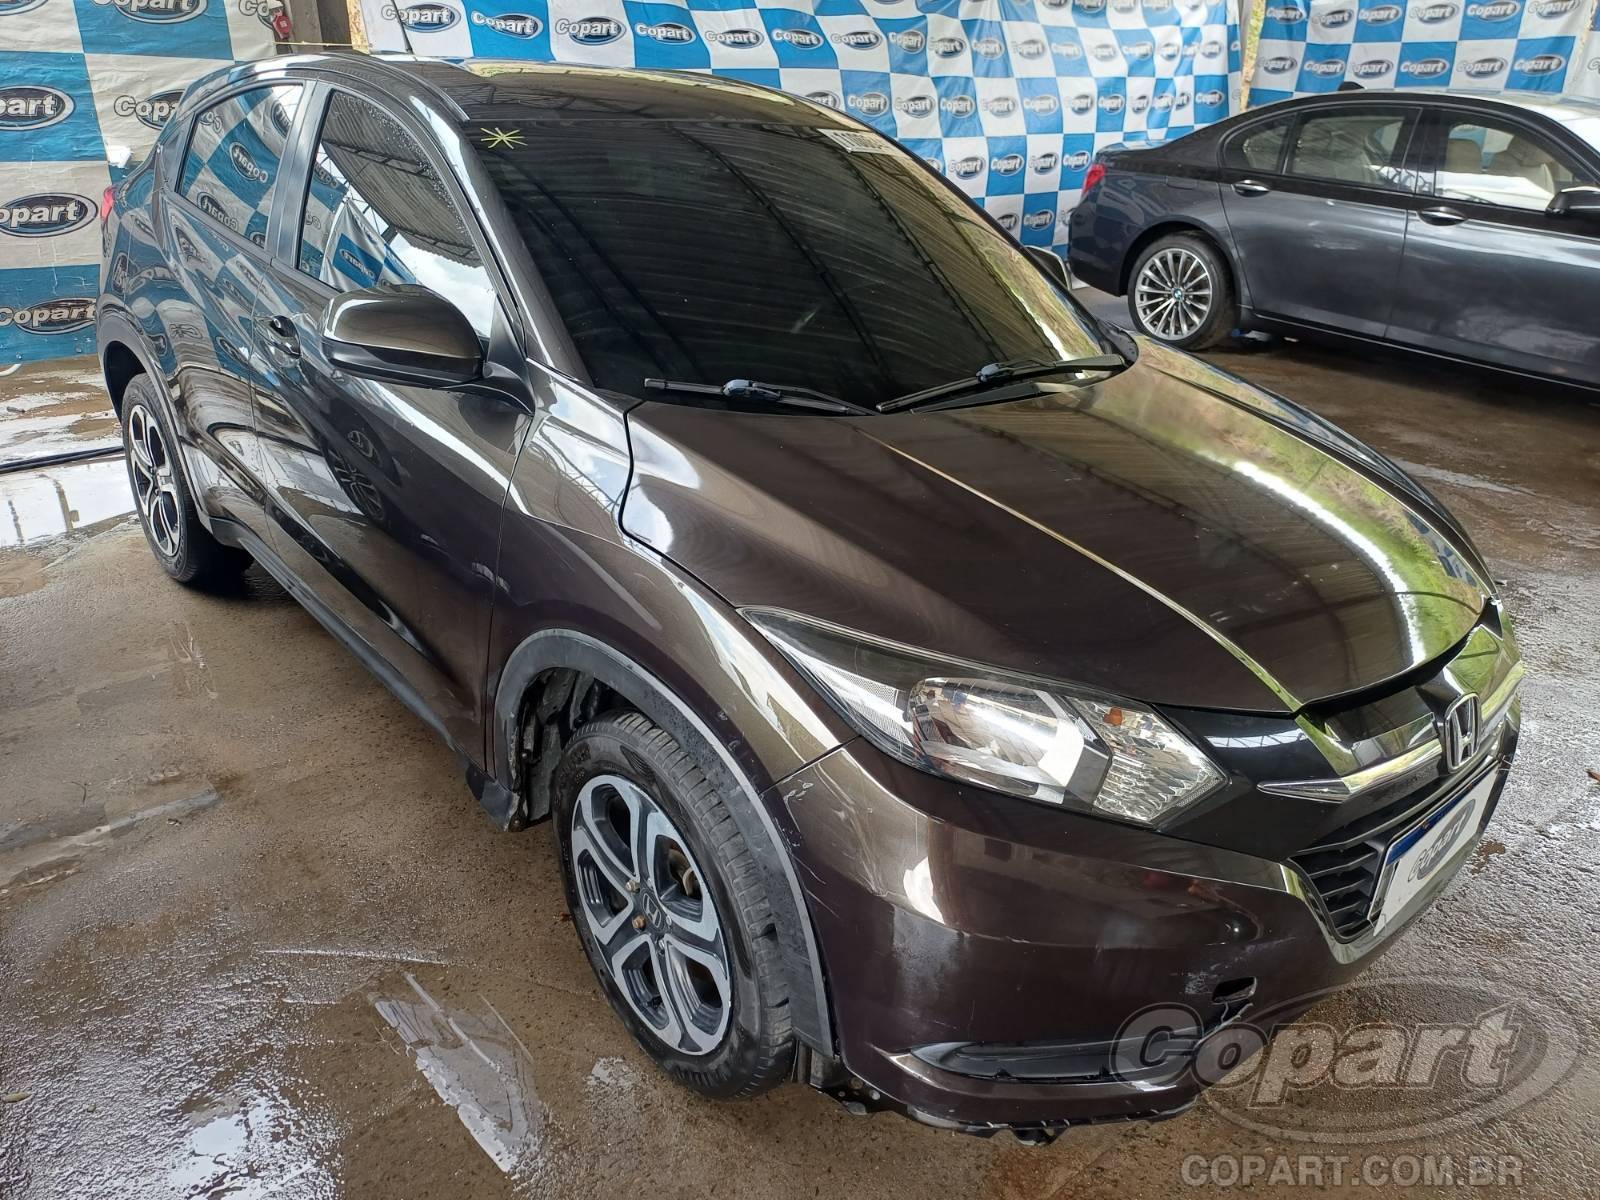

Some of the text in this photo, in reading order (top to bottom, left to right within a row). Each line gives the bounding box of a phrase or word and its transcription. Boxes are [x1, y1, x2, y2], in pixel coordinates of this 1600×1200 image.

[1267, 7, 1301, 20] Copart
[1409, 6, 1452, 19] Copart
[1467, 3, 1515, 18] Copart
[1528, 0, 1573, 16] Copart
[472, 11, 535, 33] Copart
[1312, 12, 1349, 26] Copart
[556, 19, 618, 37] Copart
[636, 23, 689, 40] Copart
[705, 31, 757, 45] Copart
[773, 29, 818, 46] Copart
[830, 32, 878, 46] Copart
[888, 32, 922, 49] Copart
[1304, 61, 1344, 75] Copart
[1400, 61, 1443, 76] Copart
[1456, 61, 1500, 76] Copart
[1514, 58, 1559, 73] Copart
[115, 95, 180, 122] Cop
[847, 95, 884, 111] Copart
[895, 97, 930, 112] Copart
[941, 98, 970, 112] Copart
